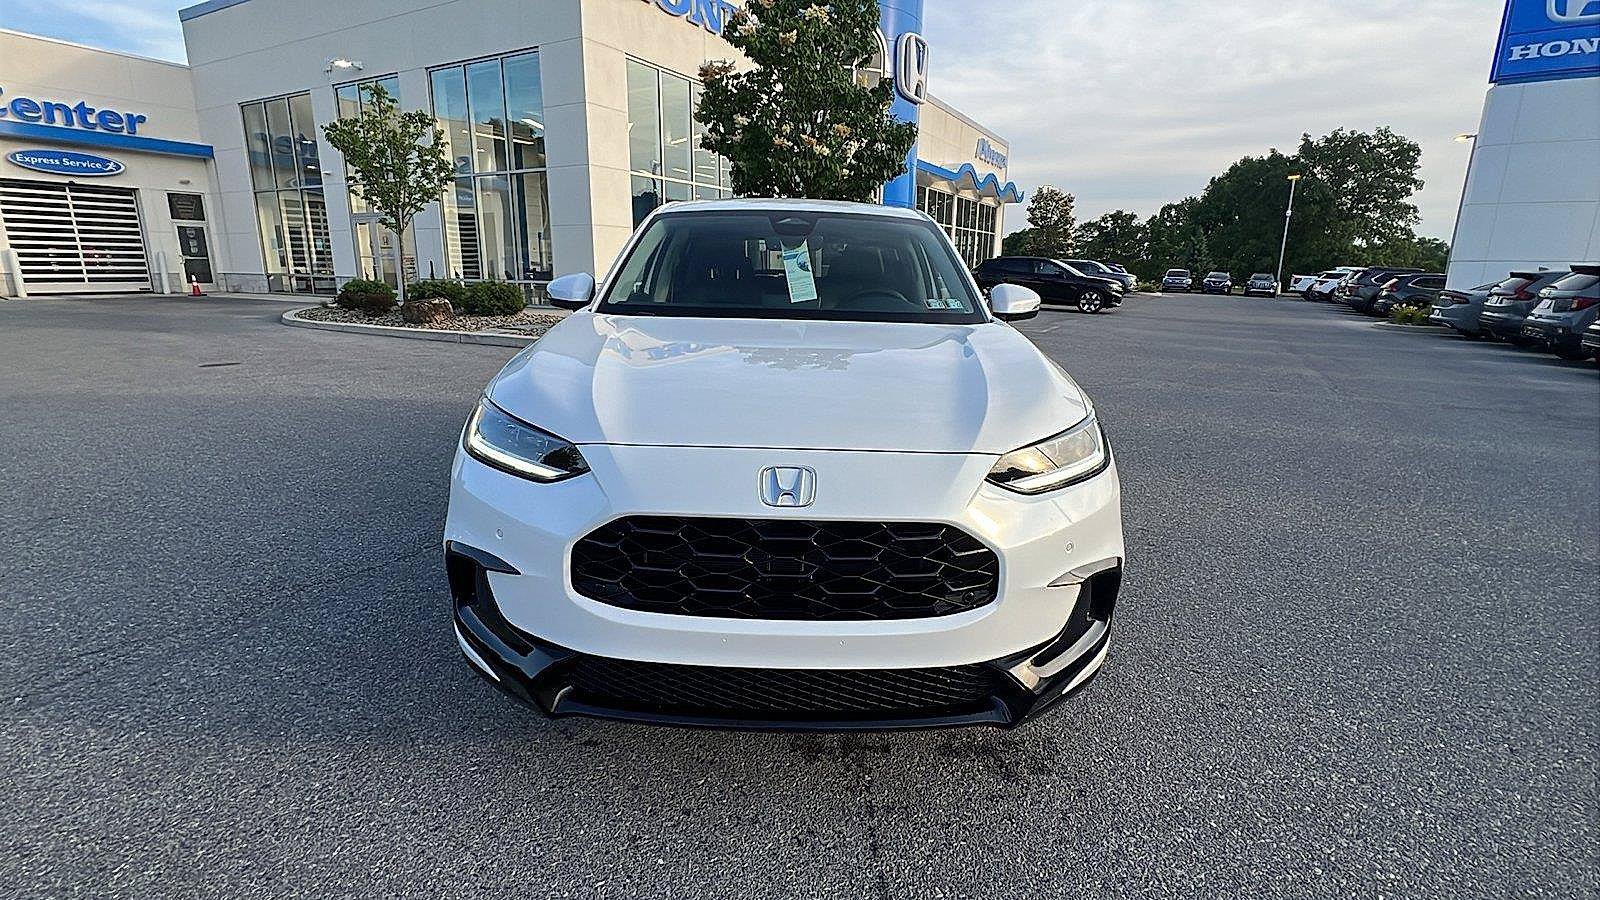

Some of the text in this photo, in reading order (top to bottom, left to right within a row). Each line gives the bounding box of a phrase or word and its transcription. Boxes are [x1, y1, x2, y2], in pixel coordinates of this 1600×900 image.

[0, 85, 147, 135] enter
[15, 152, 102, 169] Express Service
